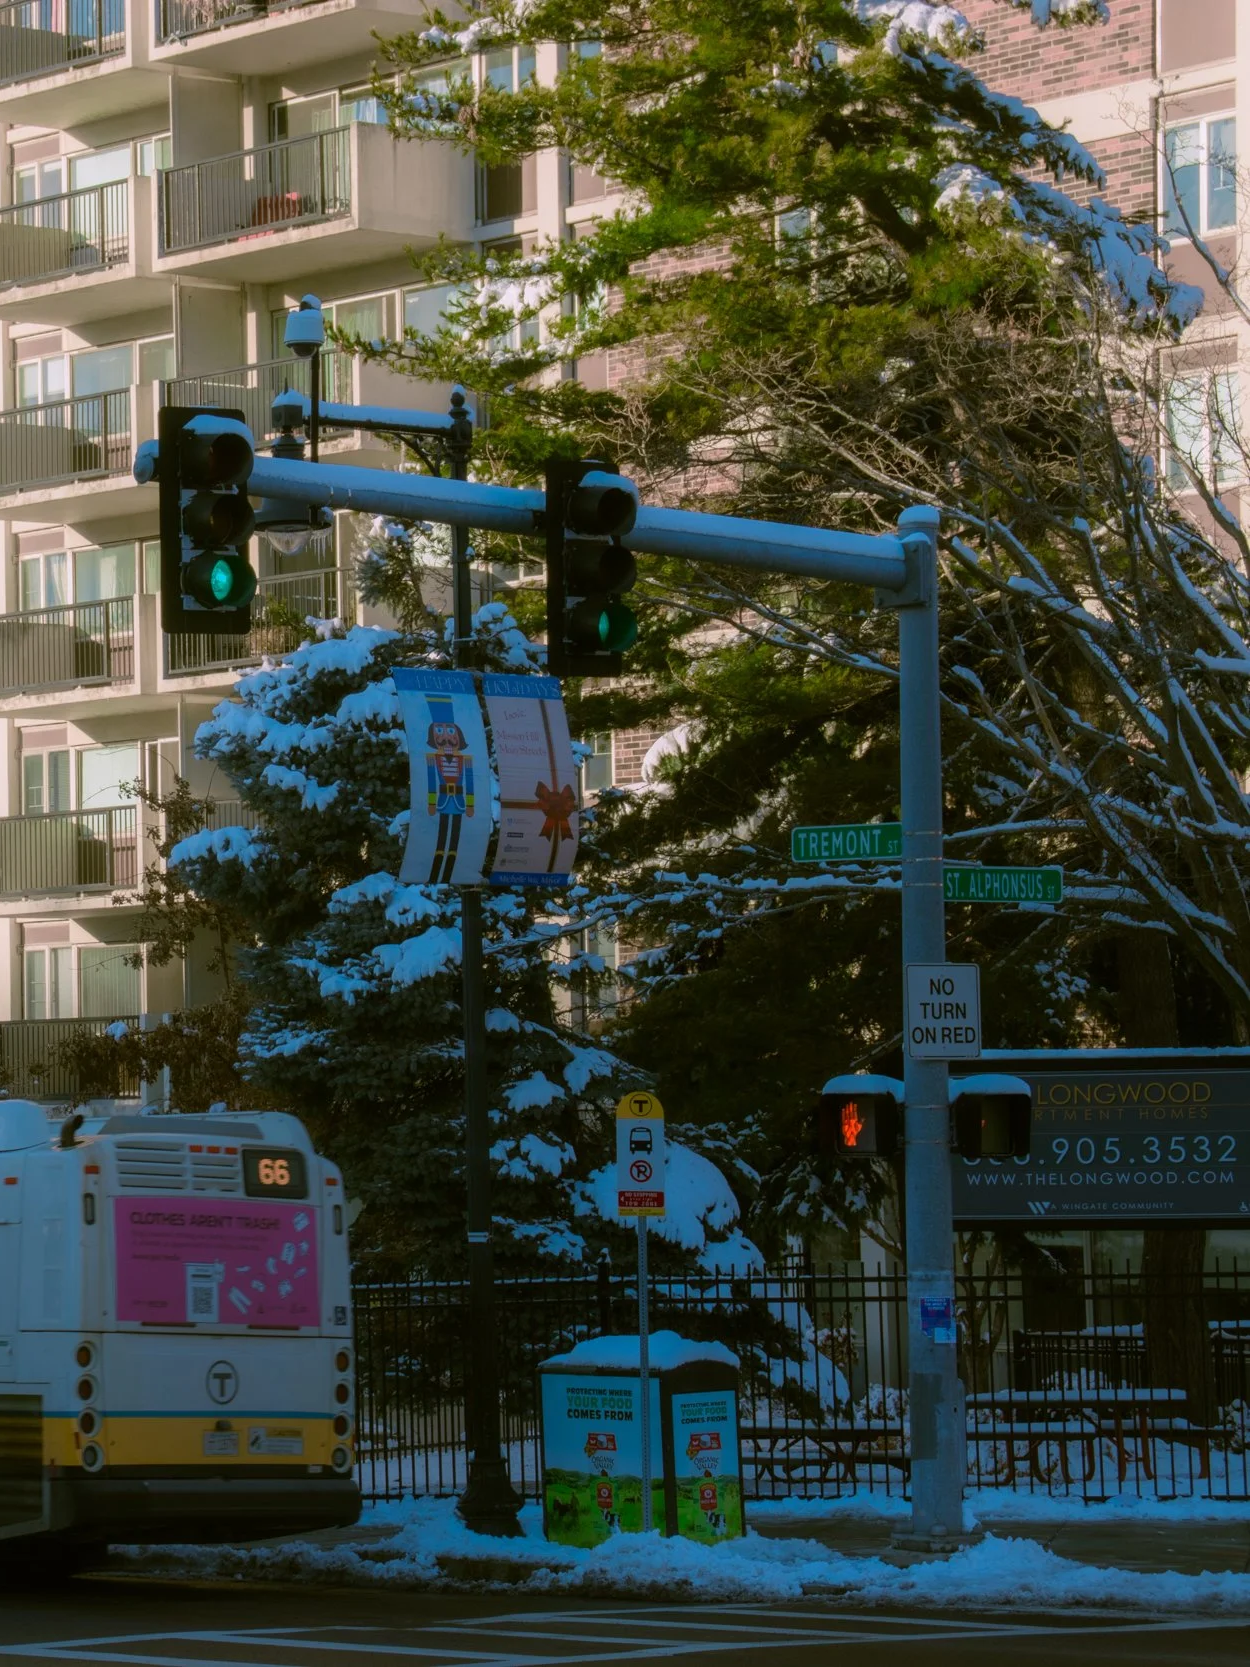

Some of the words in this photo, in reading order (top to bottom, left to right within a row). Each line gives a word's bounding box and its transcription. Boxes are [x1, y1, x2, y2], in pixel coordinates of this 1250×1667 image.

[415, 675, 469, 691] HAPPY
[484, 680, 560, 698] HOLIDAYS
[797, 829, 882, 858] TREMONT
[887, 839, 899, 854] ST
[946, 872, 965, 898] ST.
[969, 873, 1043, 899] ALPHONSUS
[1047, 885, 1055, 899] ST
[929, 977, 955, 996] NO
[919, 1001, 967, 1020] TURN
[911, 1026, 937, 1044] ON
[941, 1026, 976, 1044] RED
[1036, 1081, 1212, 1105] LONGWOOD
[633, 1100, 648, 1113] T
[1033, 1108, 1125, 1121] RTMENT
[1138, 1106, 1210, 1120] HOMES
[961, 1134, 1238, 1165] .905.3532
[257, 1157, 291, 1186] 66
[965, 1170, 1235, 1187] WWW.THELONGWOOD.COM
[1060, 1202, 1108, 1211] WINGATE
[1110, 1201, 1175, 1211] COMMUNITY
[130, 1211, 186, 1227] CLOTHES
[212, 1372, 232, 1398] T
[566, 1387, 608, 1397] PROTECTING
[609, 1389, 633, 1398] WHERE
[566, 1395, 599, 1409] YOUR
[601, 1397, 633, 1410] FOOD
[566, 1408, 602, 1421] COMES
[604, 1410, 634, 1422] FROM
[680, 1417, 706, 1425] COMES
[706, 1415, 728, 1424] FROM
[693, 1455, 719, 1465] ORGANIC
[696, 1461, 718, 1471] VALLEY
